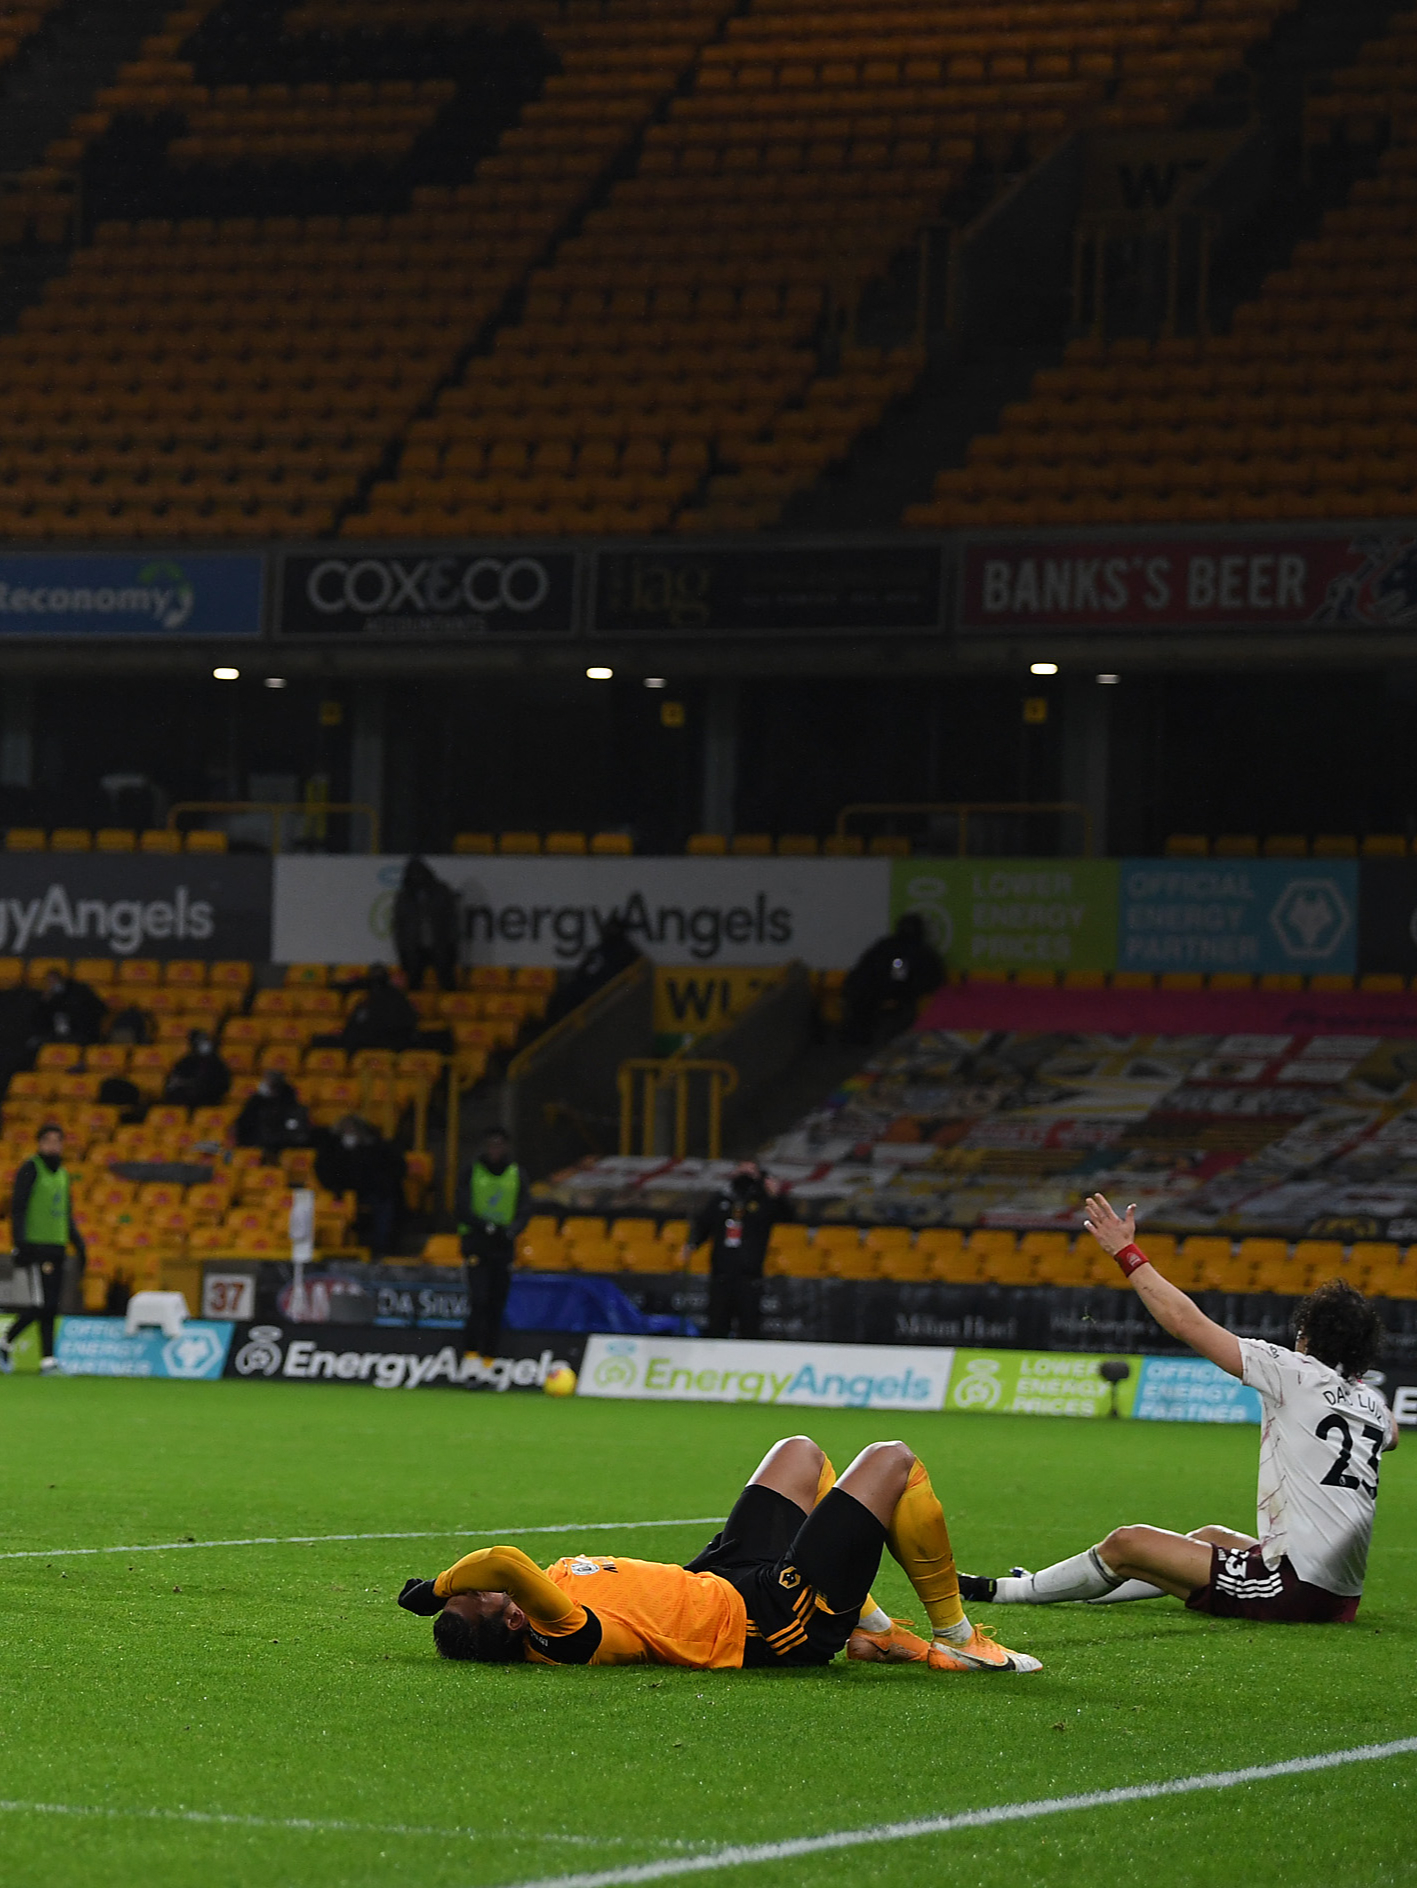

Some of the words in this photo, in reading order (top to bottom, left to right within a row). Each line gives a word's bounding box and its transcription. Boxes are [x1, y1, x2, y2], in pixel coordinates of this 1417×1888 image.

[982, 555, 1171, 613] BANKS'S
[1185, 553, 1307, 611] BEER
[972, 872, 1073, 897] LOWER
[1126, 871, 1255, 900] OFFICIAL
[464, 890, 793, 959] nergyAngels
[972, 903, 1086, 929] ENERGY
[1126, 904, 1245, 930] ENERGY
[970, 934, 1072, 960] PRICES
[1125, 935, 1260, 963] PARTNER
[210, 1282, 245, 1313] 37
[644, 1358, 930, 1409] EnergyAngels
[1143, 1380, 1236, 1401] ENERGY
[1139, 1400, 1245, 1421] PARTNER
[1315, 1413, 1384, 1500] 23
